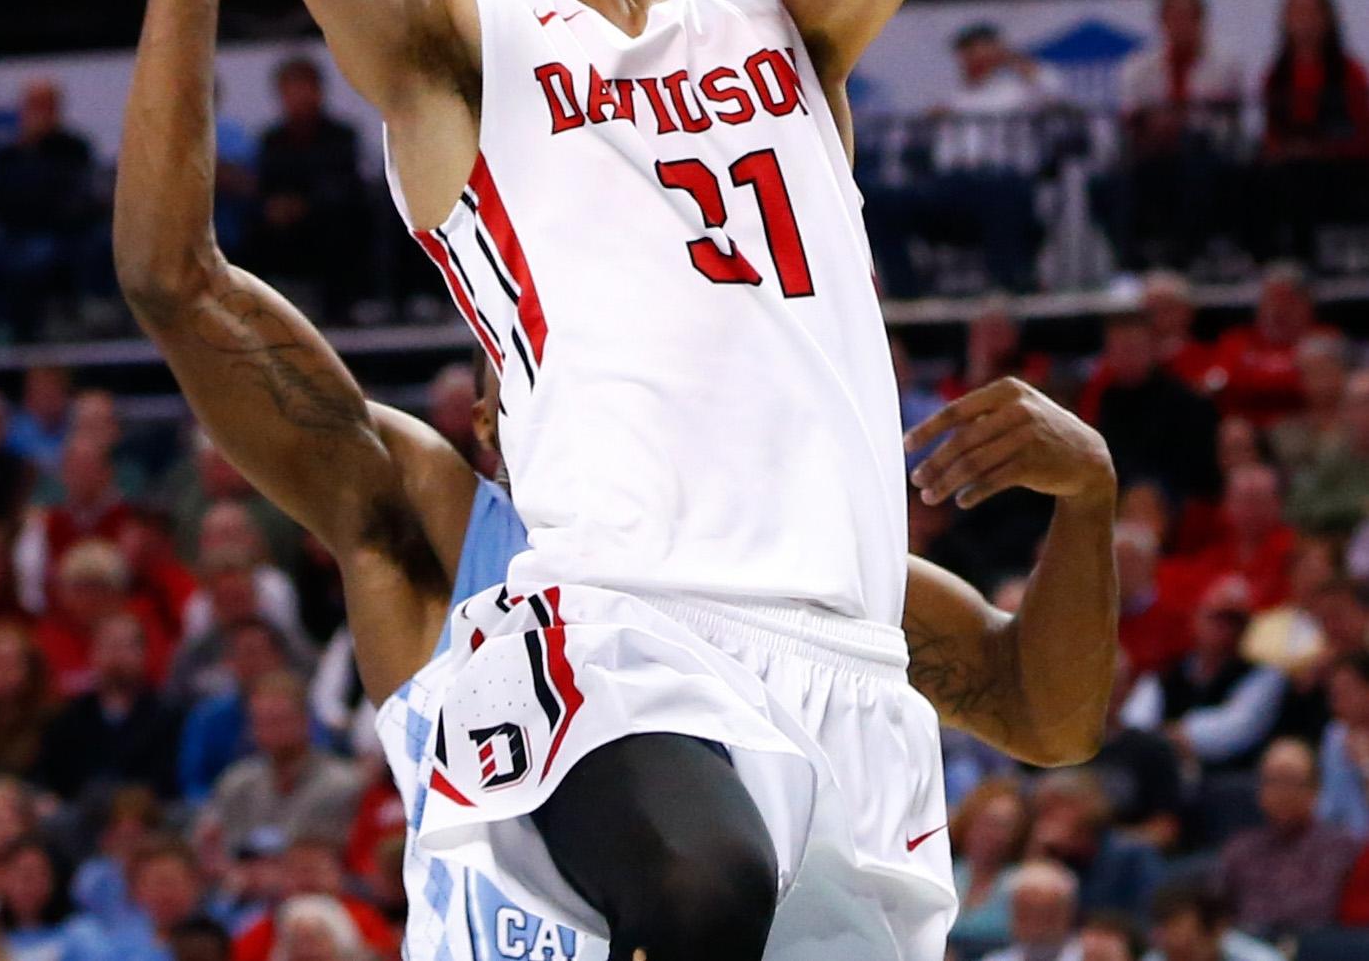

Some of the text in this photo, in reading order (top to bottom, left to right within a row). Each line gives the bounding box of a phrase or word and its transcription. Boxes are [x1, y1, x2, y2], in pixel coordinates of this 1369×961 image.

[534, 47, 809, 135] DAVIDSO
[655, 148, 816, 299] 31
[494, 905, 580, 961] CA
